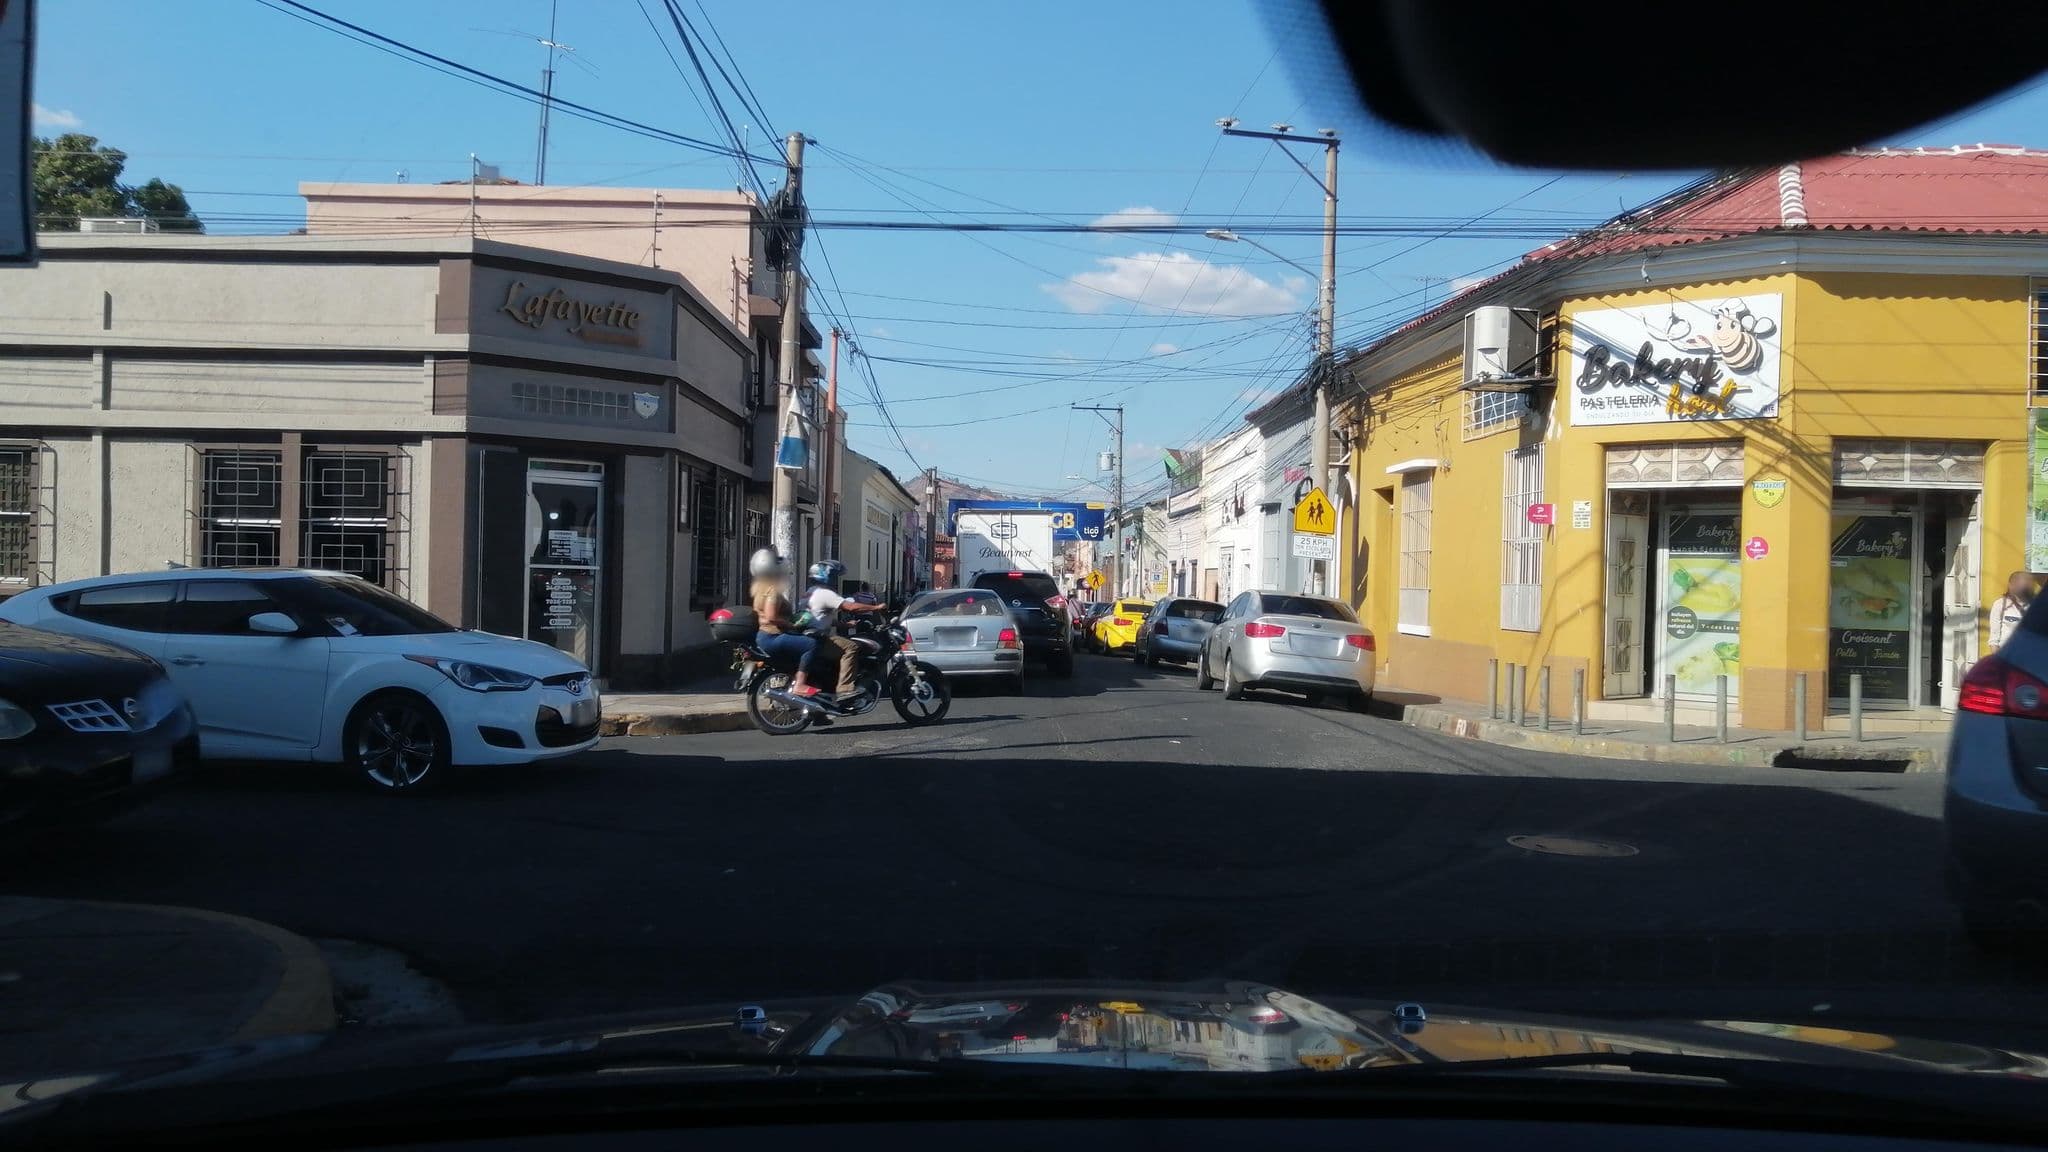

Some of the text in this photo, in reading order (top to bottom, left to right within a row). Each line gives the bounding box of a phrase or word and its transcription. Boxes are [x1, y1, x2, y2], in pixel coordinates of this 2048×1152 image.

[502, 281, 640, 333] Lafayette
[1577, 341, 1722, 389] Bakery
[1083, 527, 1099, 538] tigo
[1696, 525, 1735, 538] Bakery
[1301, 537, 1328, 546] 25 KPH
[1856, 539, 1894, 553] Bakery
[1842, 630, 1896, 644] Croissant
